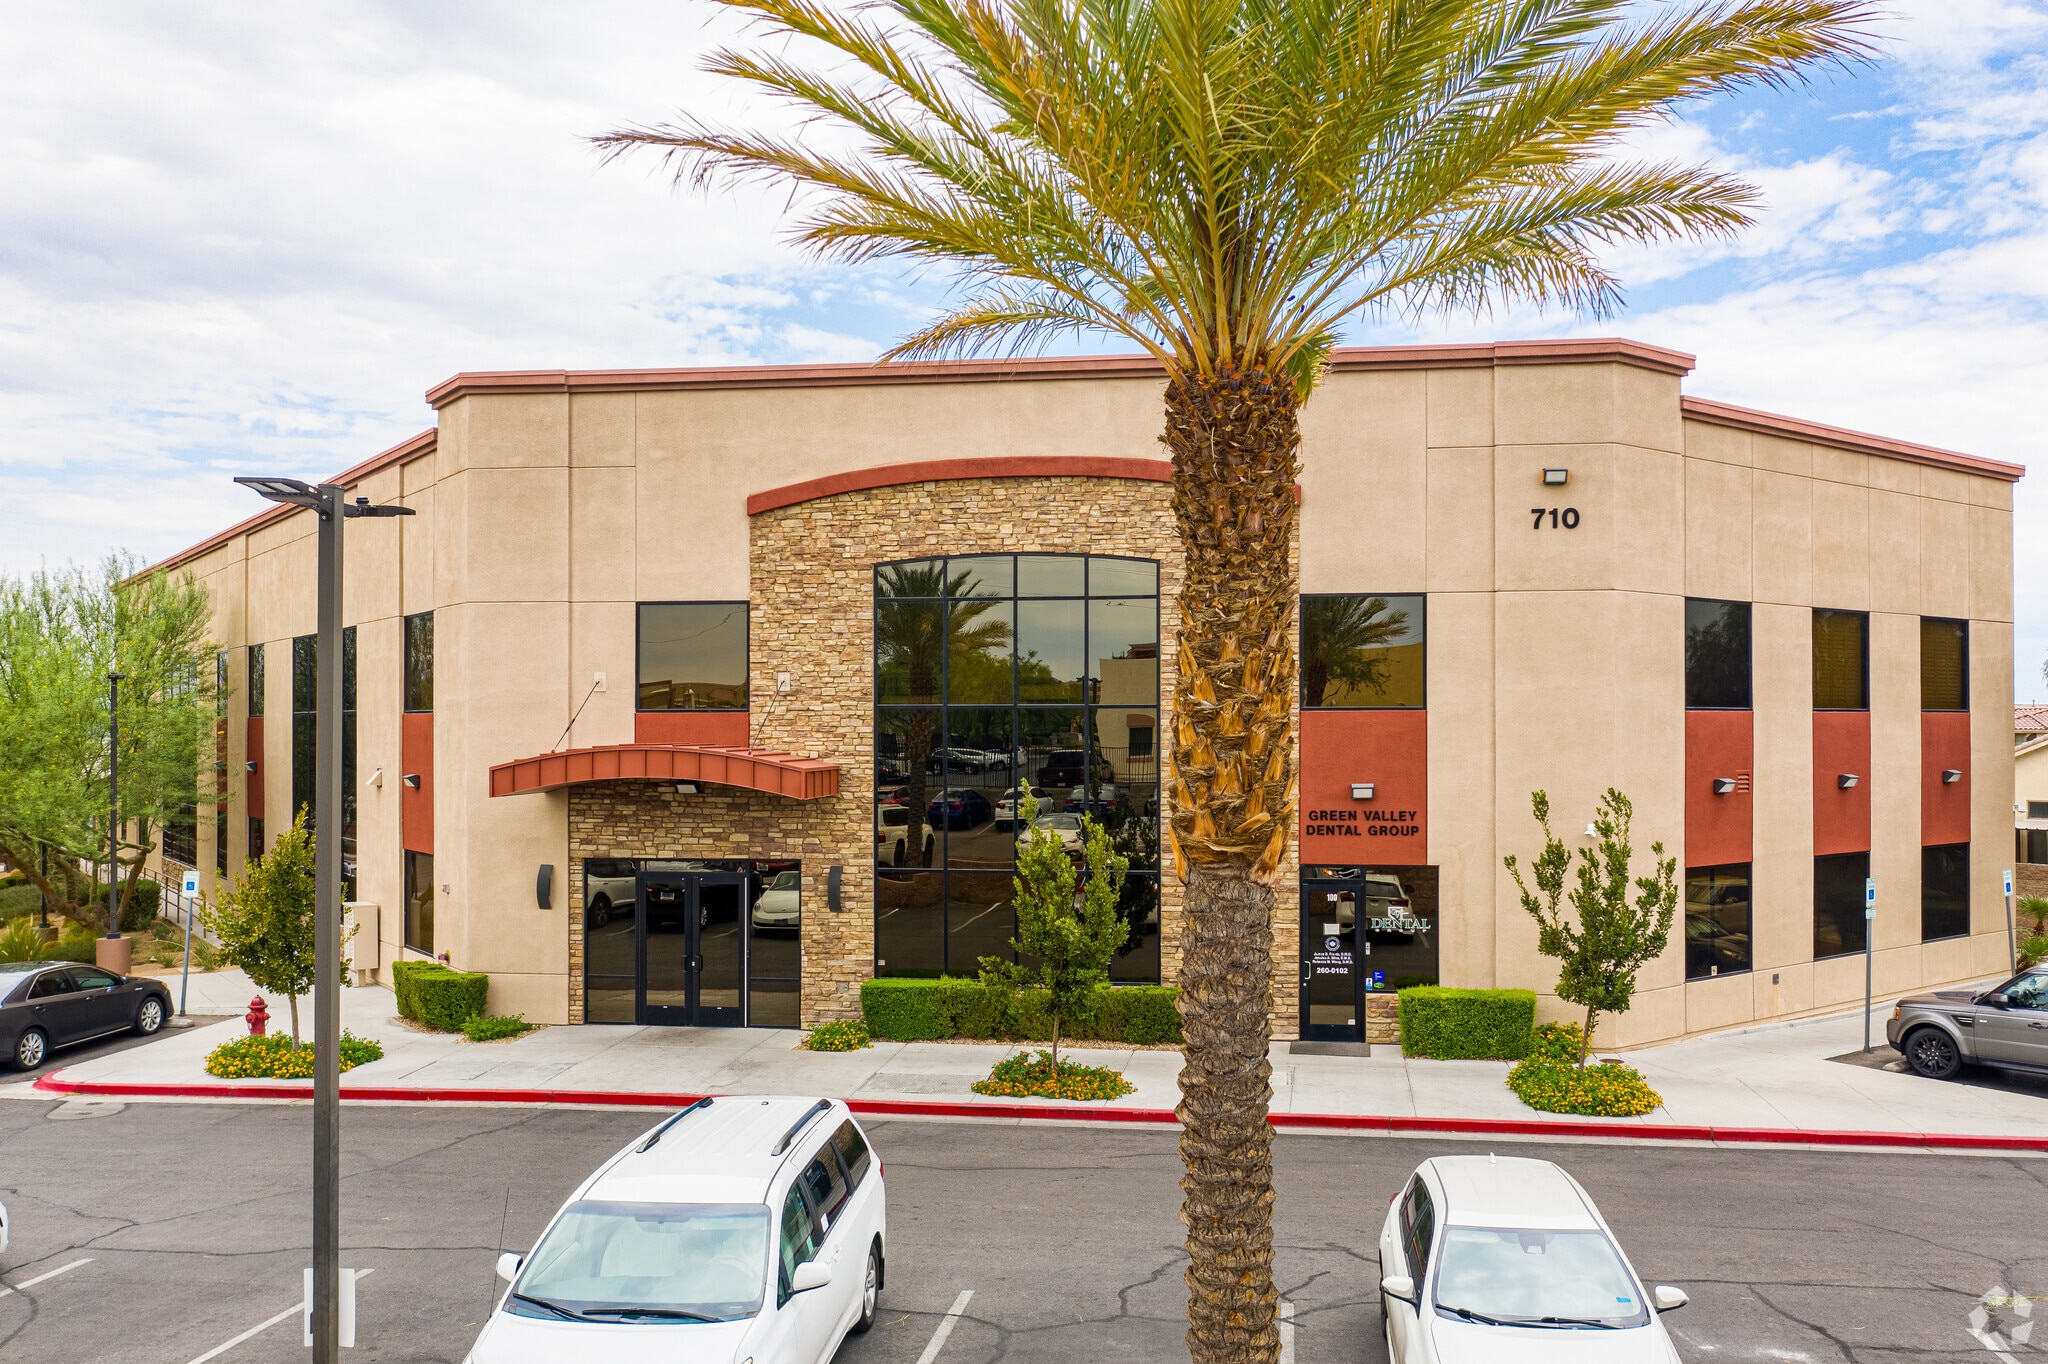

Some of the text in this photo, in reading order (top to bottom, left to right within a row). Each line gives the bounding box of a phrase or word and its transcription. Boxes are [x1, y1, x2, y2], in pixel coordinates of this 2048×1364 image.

[1530, 507, 1580, 529] 710
[1308, 810, 1417, 821] GREEN VALLEY
[1306, 825, 1419, 837] DENTAL GROUP
[1327, 893, 1338, 902] 100
[1371, 917, 1431, 929] DENTAL
